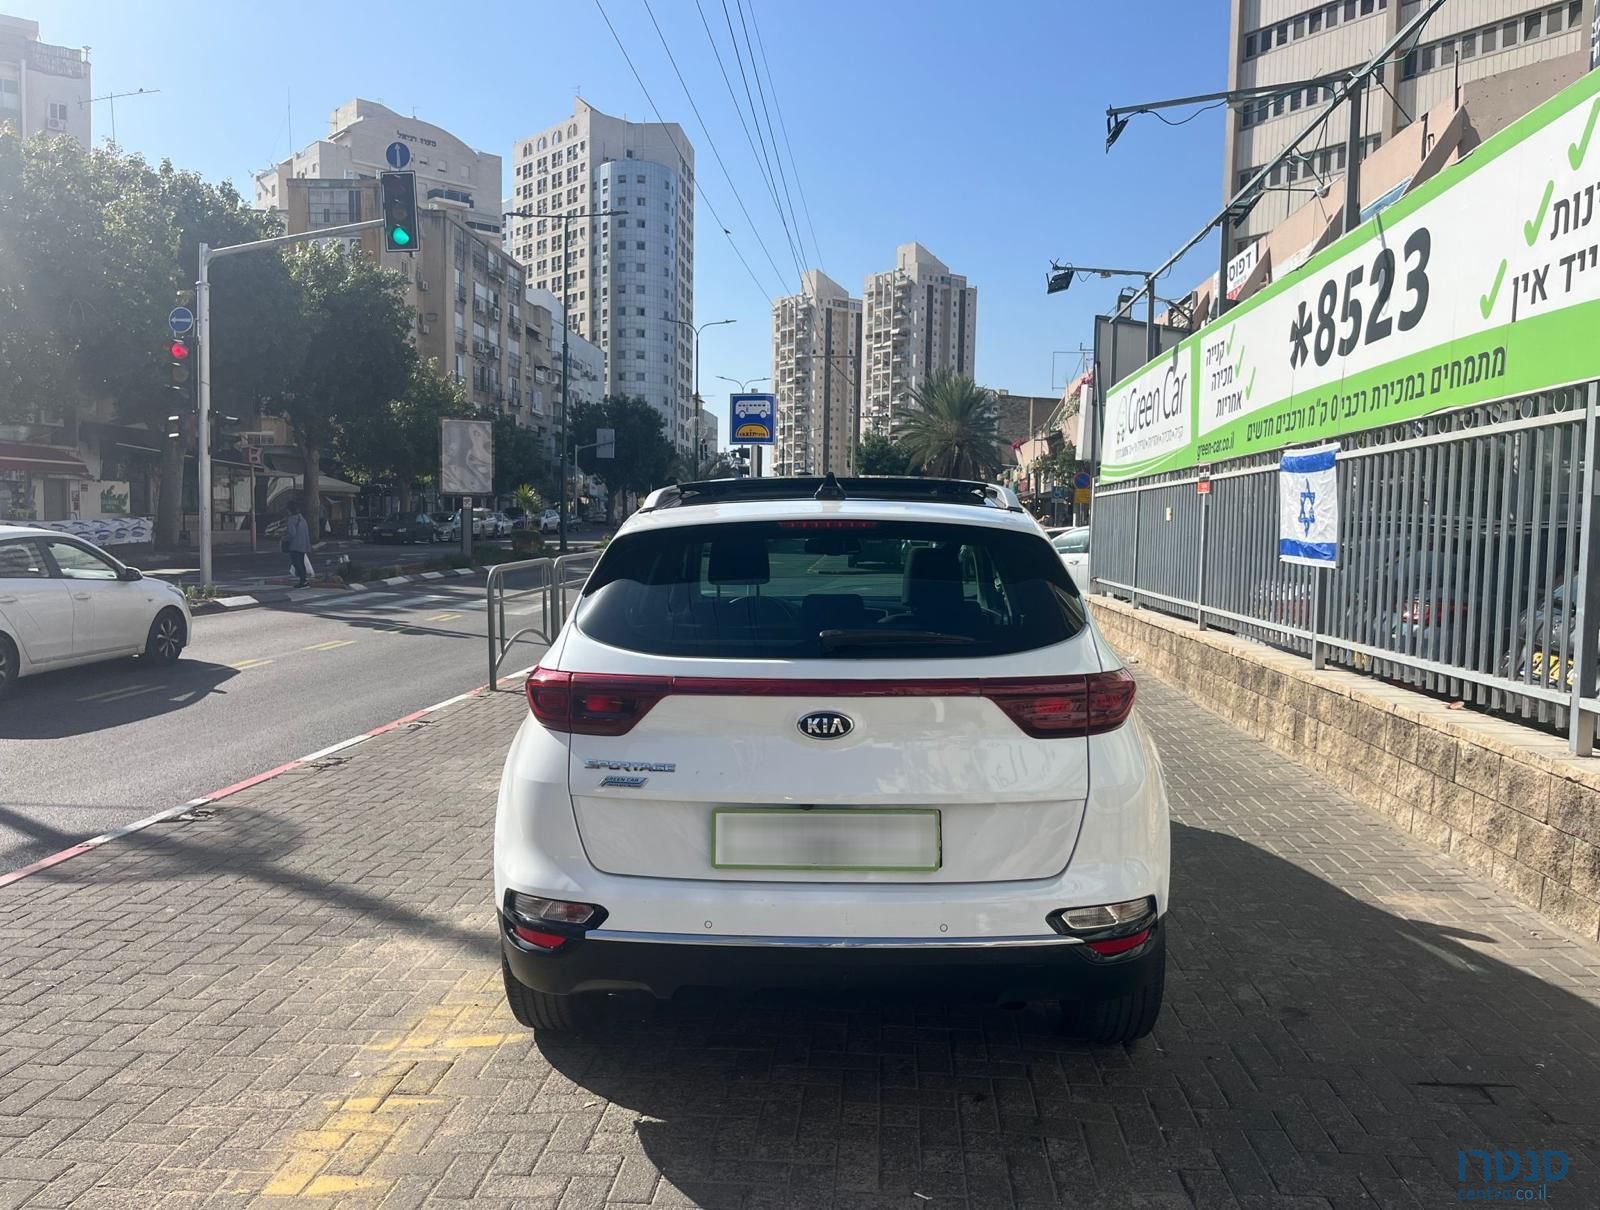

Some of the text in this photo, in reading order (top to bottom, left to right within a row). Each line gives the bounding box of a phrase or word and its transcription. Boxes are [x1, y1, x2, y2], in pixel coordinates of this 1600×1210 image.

[1550, 181, 1600, 241] נות
[1228, 251, 1252, 282] דפוס
[1511, 264, 1550, 323] אין
[1206, 340, 1225, 367] קנייה
[1211, 365, 1233, 391] מכירה
[1430, 346, 1506, 395] מתמחים
[1128, 366, 1188, 434] Green Car
[1216, 390, 1243, 418] אחריות
[1341, 390, 1367, 418] רכבי
[1370, 372, 1425, 411] במכירת
[1275, 408, 1306, 434] ורכבים
[1307, 398, 1328, 427] ק"מ
[1246, 418, 1274, 441] חדשים
[1197, 432, 1235, 460] green-car.co.il
[807, 717, 845, 733] KIA
[584, 759, 676, 773] SPORTAGE
